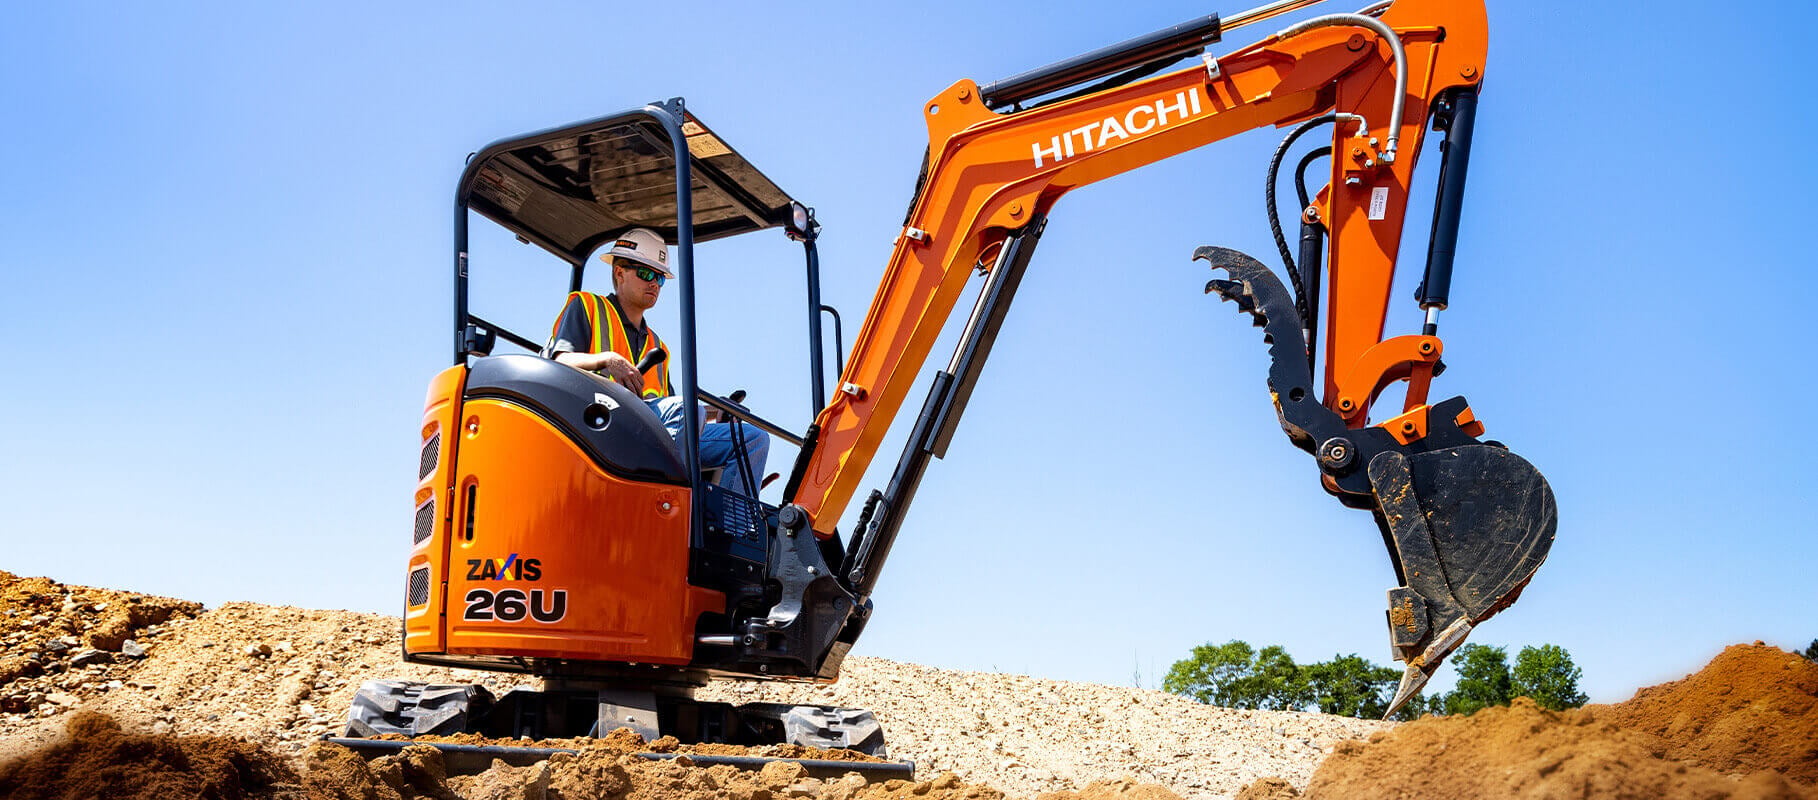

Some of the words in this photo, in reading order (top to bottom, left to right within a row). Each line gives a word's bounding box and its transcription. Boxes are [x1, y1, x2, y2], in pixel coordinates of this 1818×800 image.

[1031, 87, 1202, 169] HITACHI
[466, 553, 542, 582] ZAXIS
[463, 588, 568, 624] 26U
